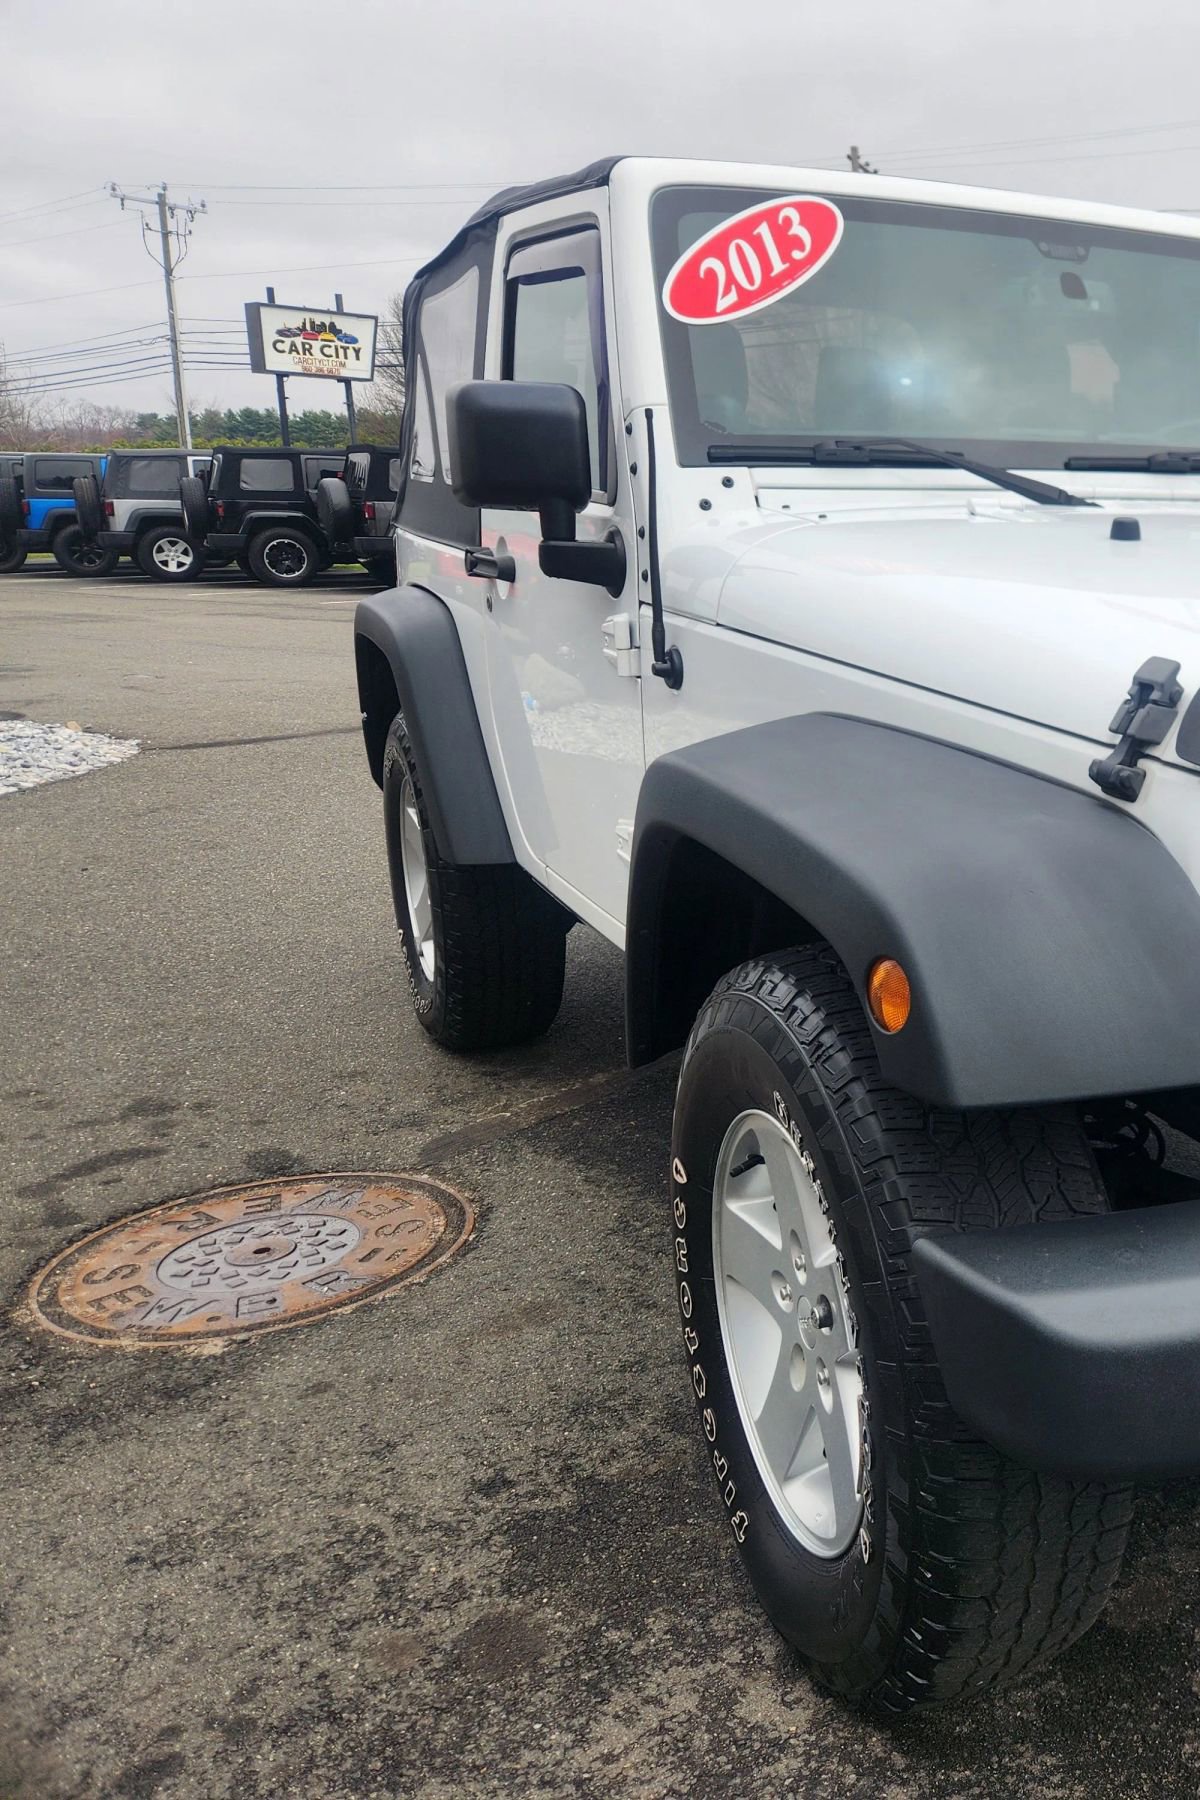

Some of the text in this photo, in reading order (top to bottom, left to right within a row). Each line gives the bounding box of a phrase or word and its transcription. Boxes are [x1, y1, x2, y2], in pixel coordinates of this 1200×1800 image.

[699, 206, 812, 313] 2013
[273, 339, 362, 361] CAR CITY
